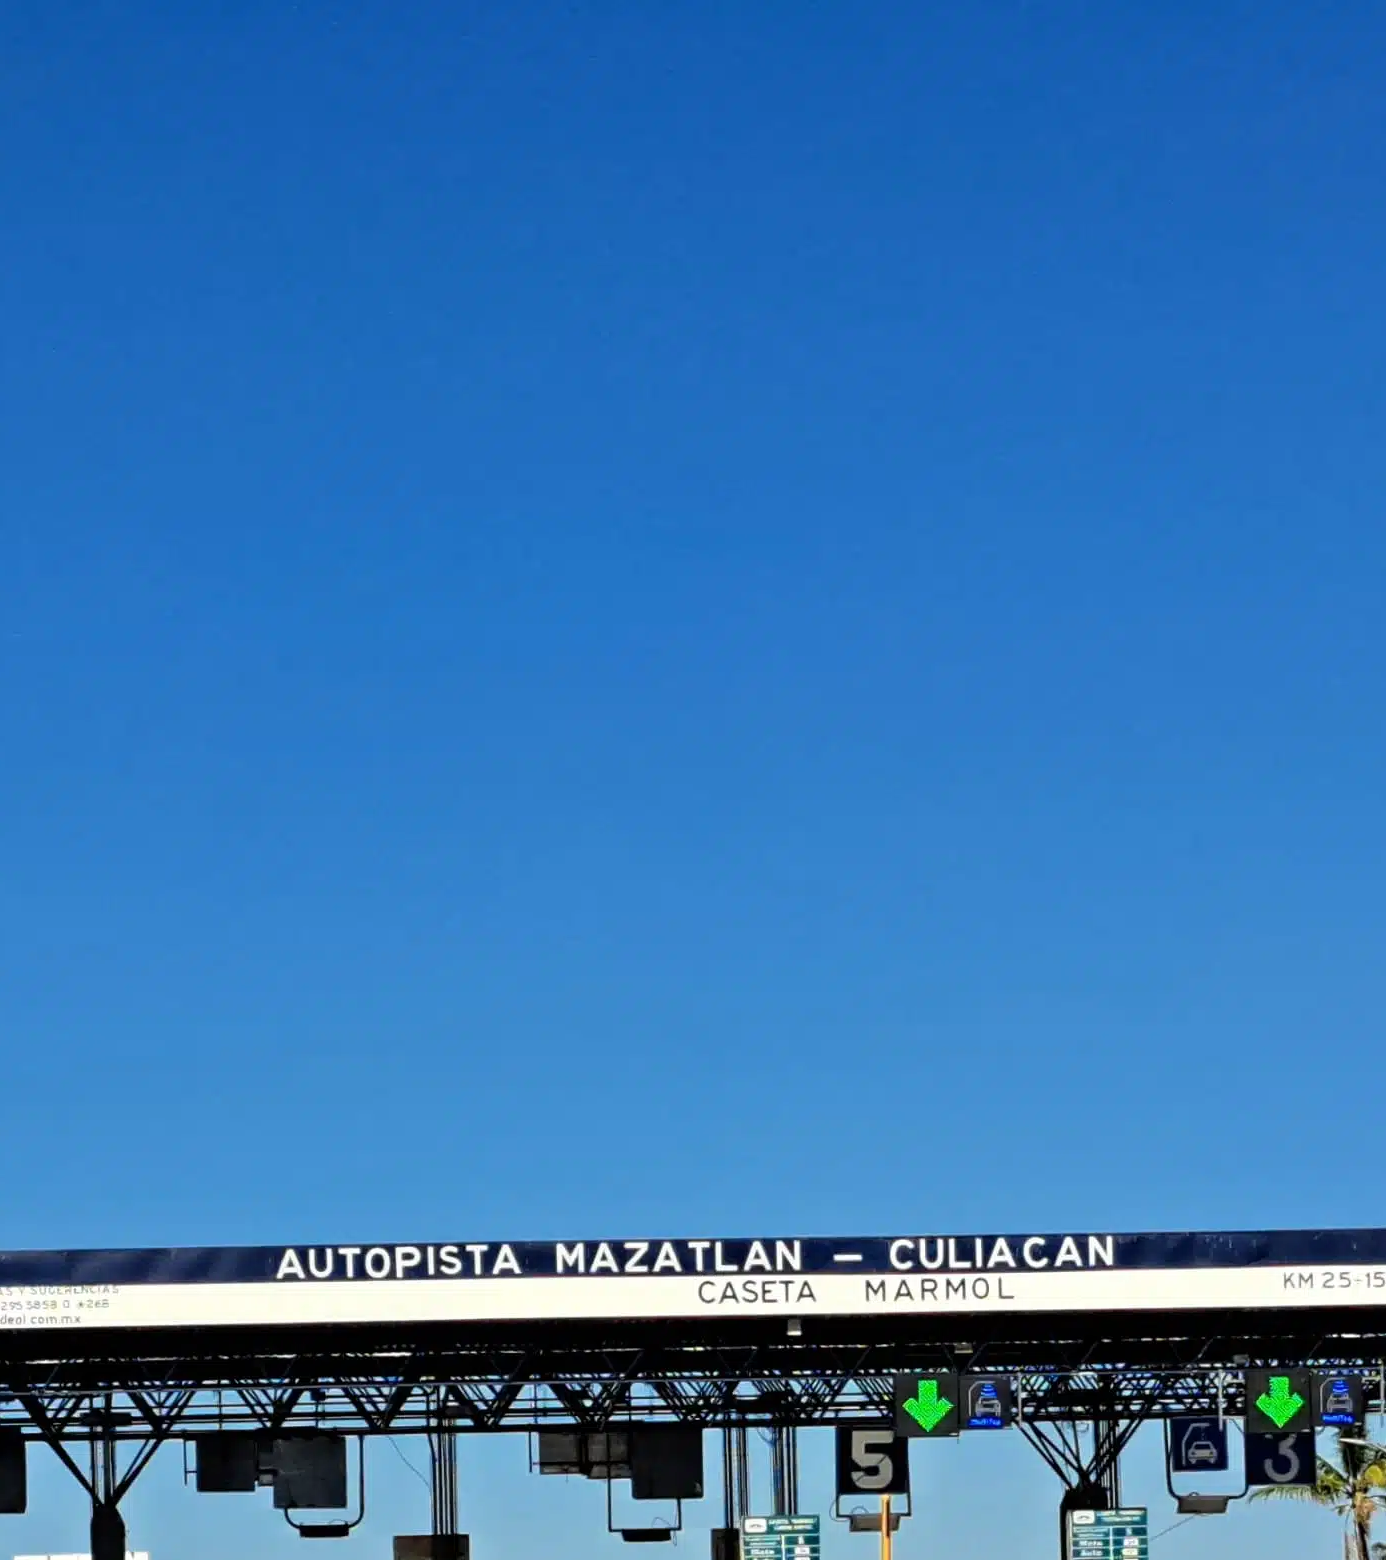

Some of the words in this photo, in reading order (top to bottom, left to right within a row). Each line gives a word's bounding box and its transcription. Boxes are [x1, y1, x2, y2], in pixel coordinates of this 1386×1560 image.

[276, 1244, 521, 1280] AUTOPISTA
[555, 1240, 801, 1274] MAZATLAN
[890, 1236, 1113, 1270] CULIACAN
[1283, 1271, 1314, 1289] KM
[698, 1280, 817, 1304] CASETA
[865, 1277, 1015, 1302] MARMOL
[851, 1430, 894, 1489] 5
[1264, 1433, 1300, 1482] 3
